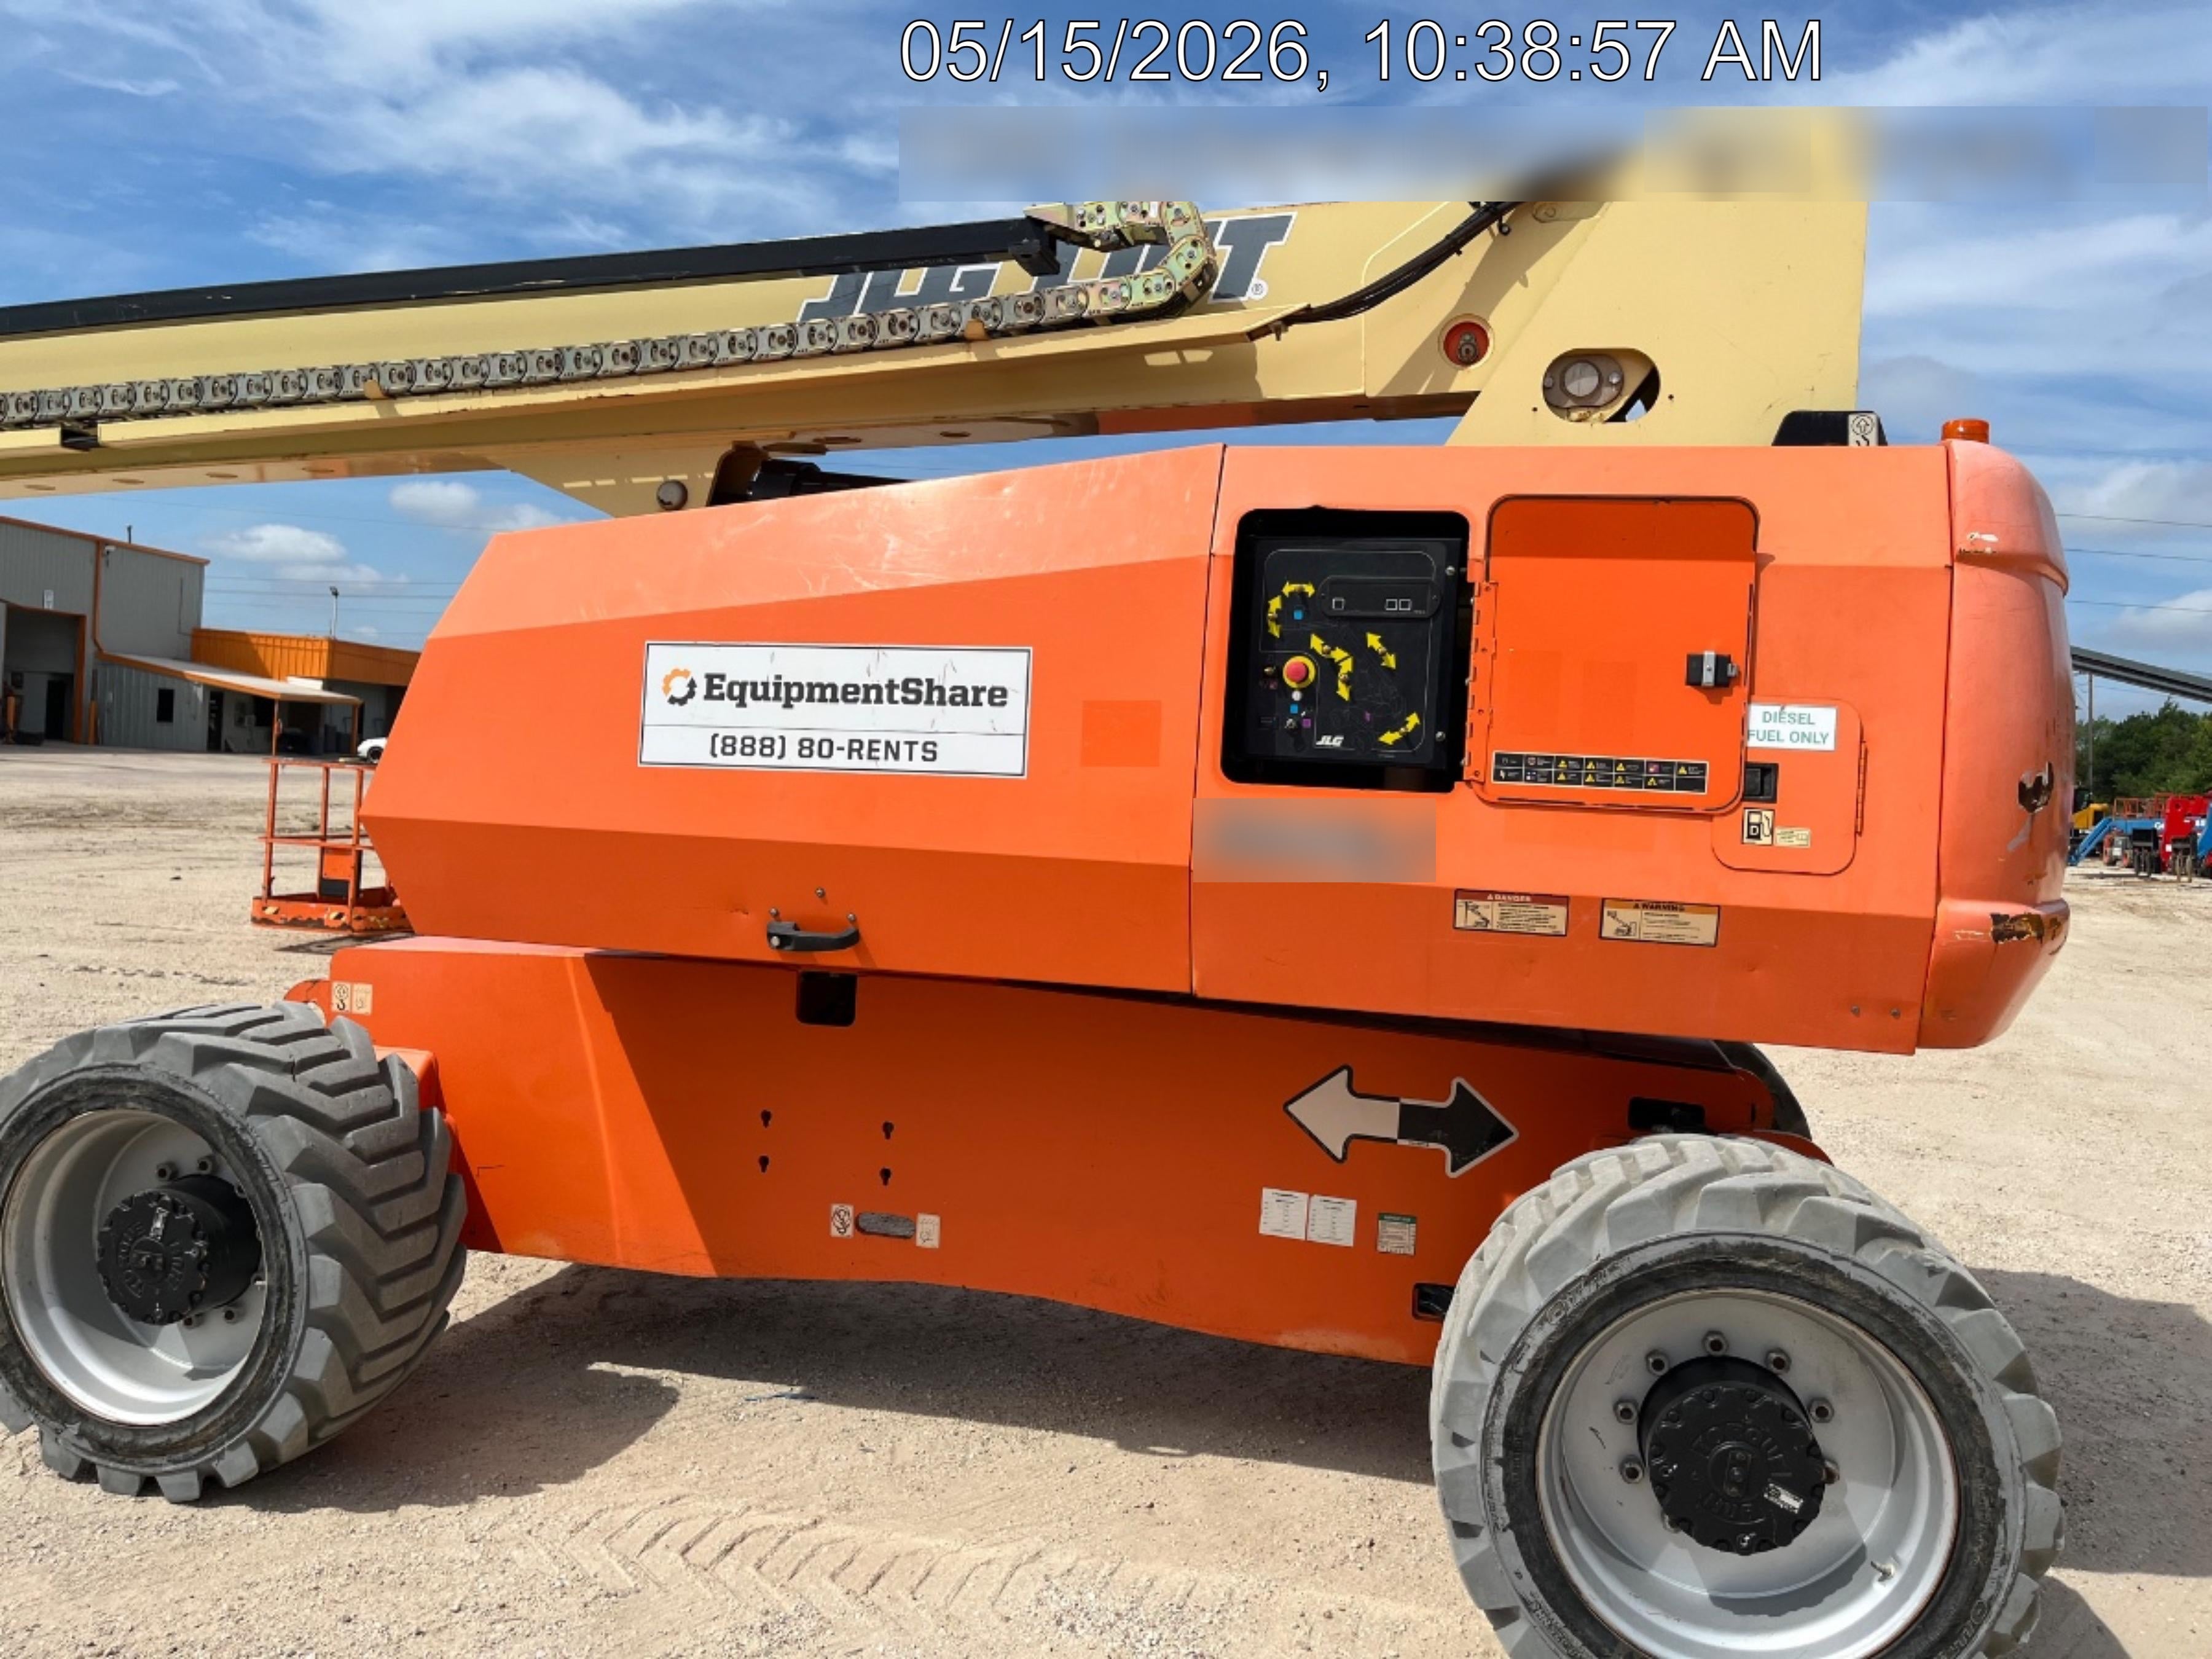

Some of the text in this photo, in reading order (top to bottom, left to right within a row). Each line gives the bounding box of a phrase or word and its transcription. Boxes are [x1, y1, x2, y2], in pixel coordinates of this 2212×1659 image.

[704, 672, 1008, 708] EquipmentShare
[1762, 710, 1816, 725] DIESEL
[1316, 735, 1344, 747] JLG
[1747, 729, 1829, 745] FUEL ONLY
[709, 733, 938, 763] (888) 80-RENTS
[1750, 825, 1759, 836] D
[1642, 903, 1685, 912] WARNING
